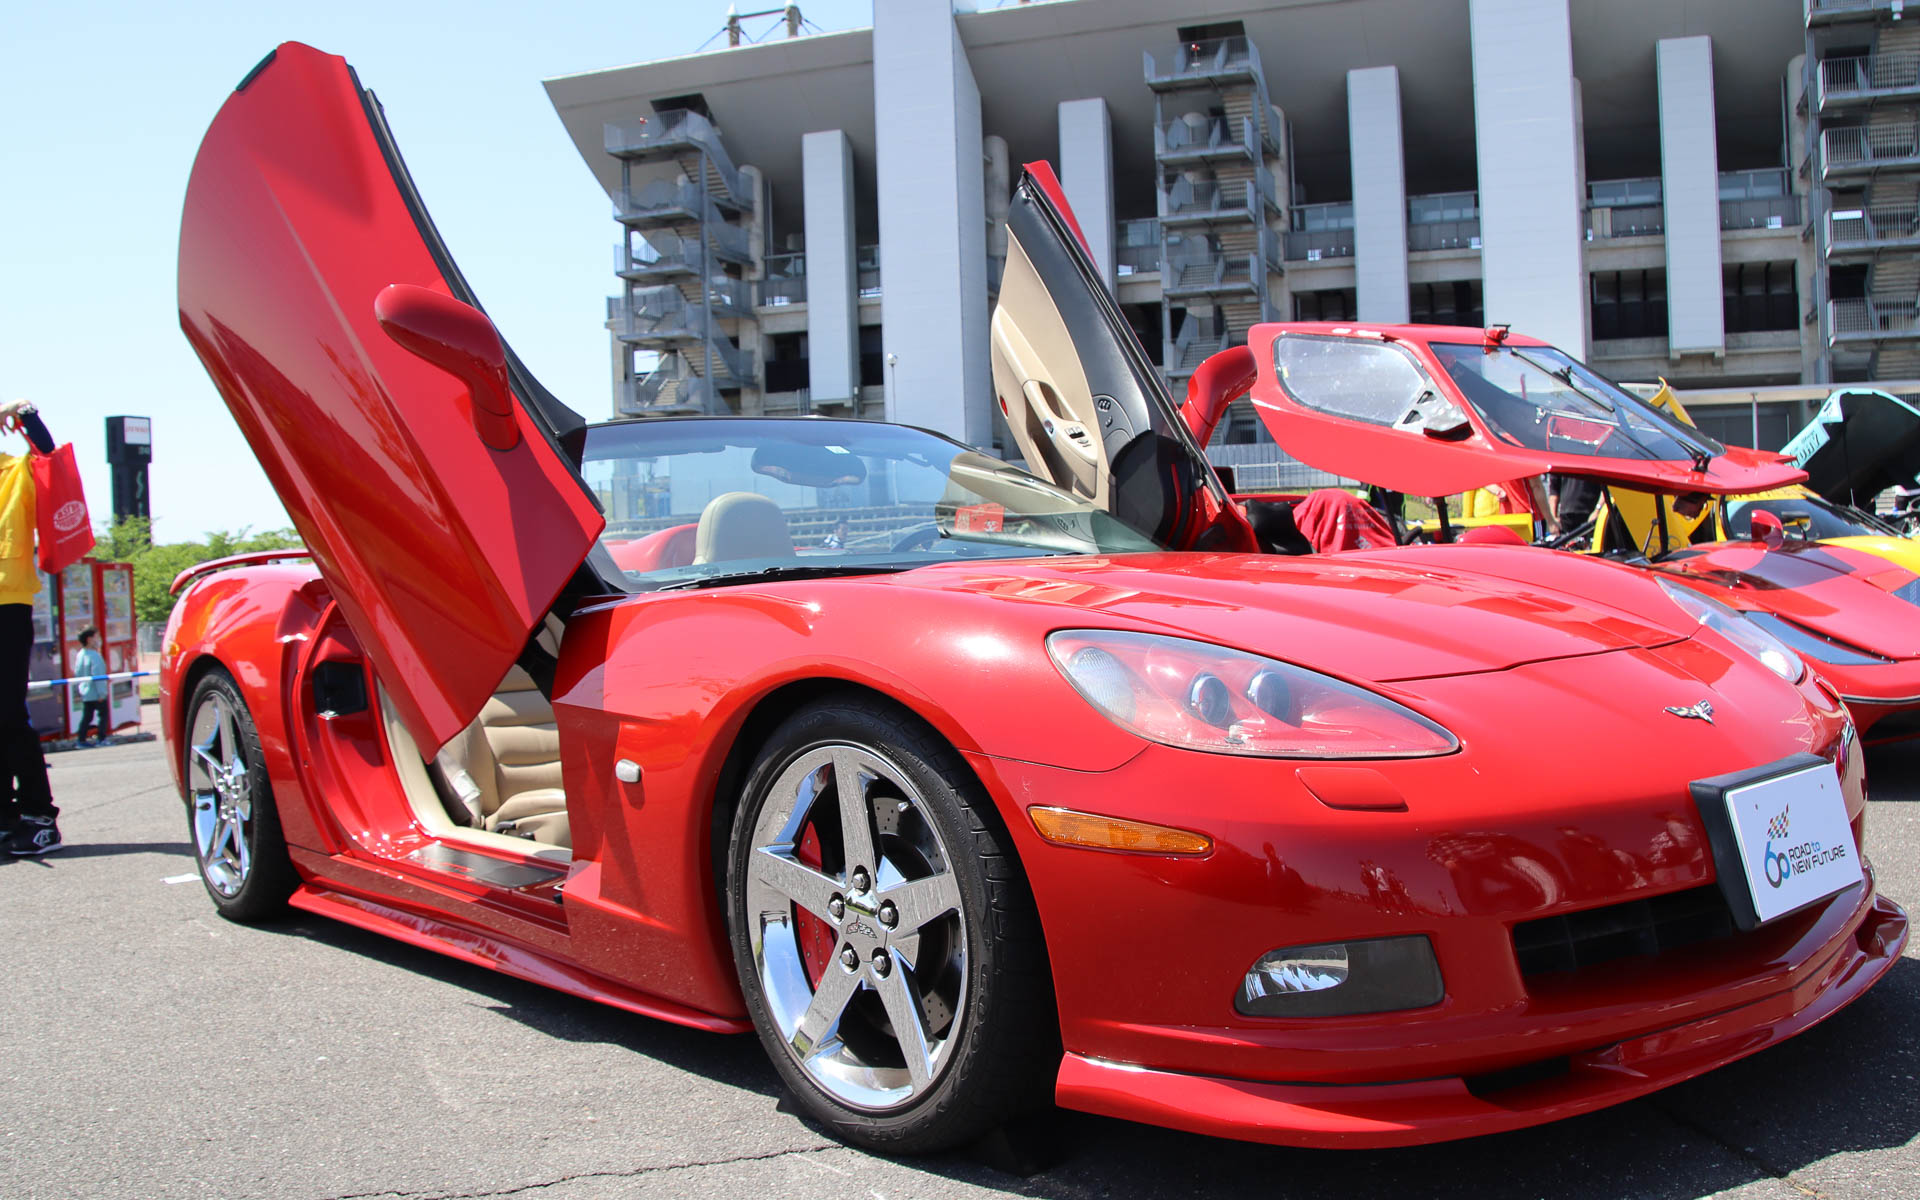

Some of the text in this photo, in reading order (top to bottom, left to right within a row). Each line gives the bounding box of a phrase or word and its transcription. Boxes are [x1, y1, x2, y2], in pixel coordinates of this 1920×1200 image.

[1788, 841, 1821, 861] ROAD to
[1792, 845, 1846, 875] NEW FUTURE
